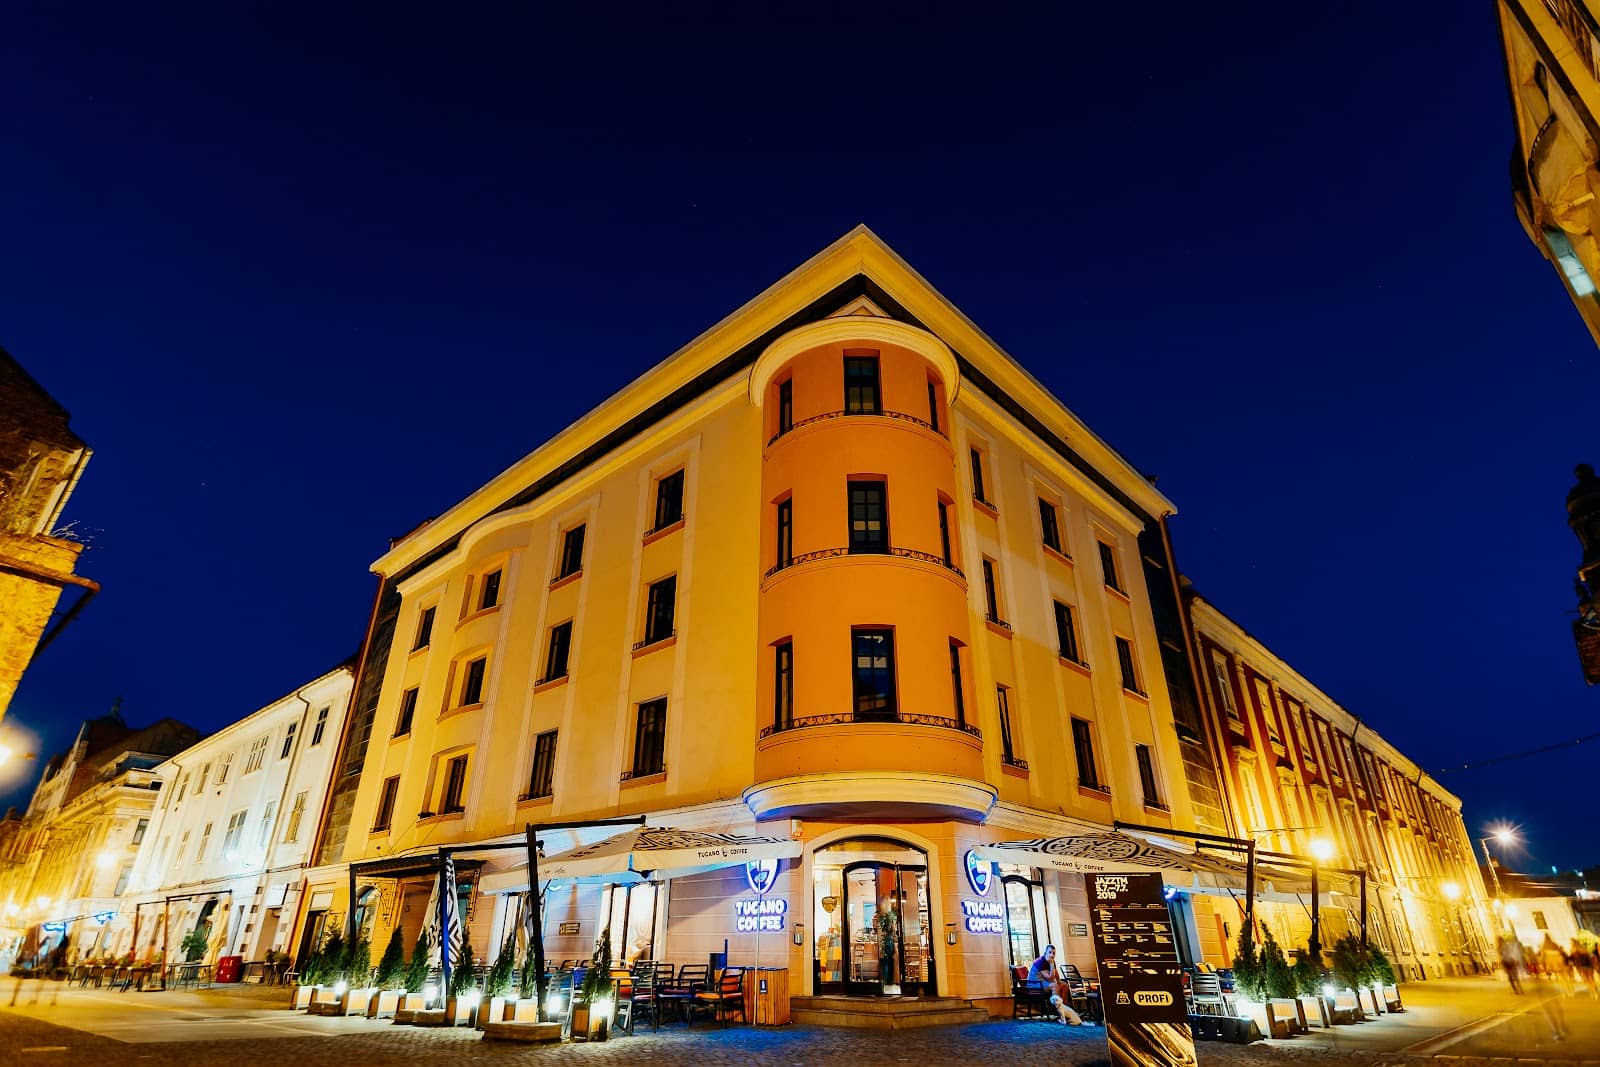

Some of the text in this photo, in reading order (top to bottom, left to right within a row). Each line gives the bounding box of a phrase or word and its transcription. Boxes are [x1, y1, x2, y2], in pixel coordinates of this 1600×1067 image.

[1097, 891, 1117, 899] 2019
[736, 899, 786, 915] TUCANO
[962, 900, 1003, 917] TUCANO
[737, 915, 783, 931] COFFEE
[967, 917, 1004, 933] COFFEE
[1138, 994, 1169, 1004] PROFI
